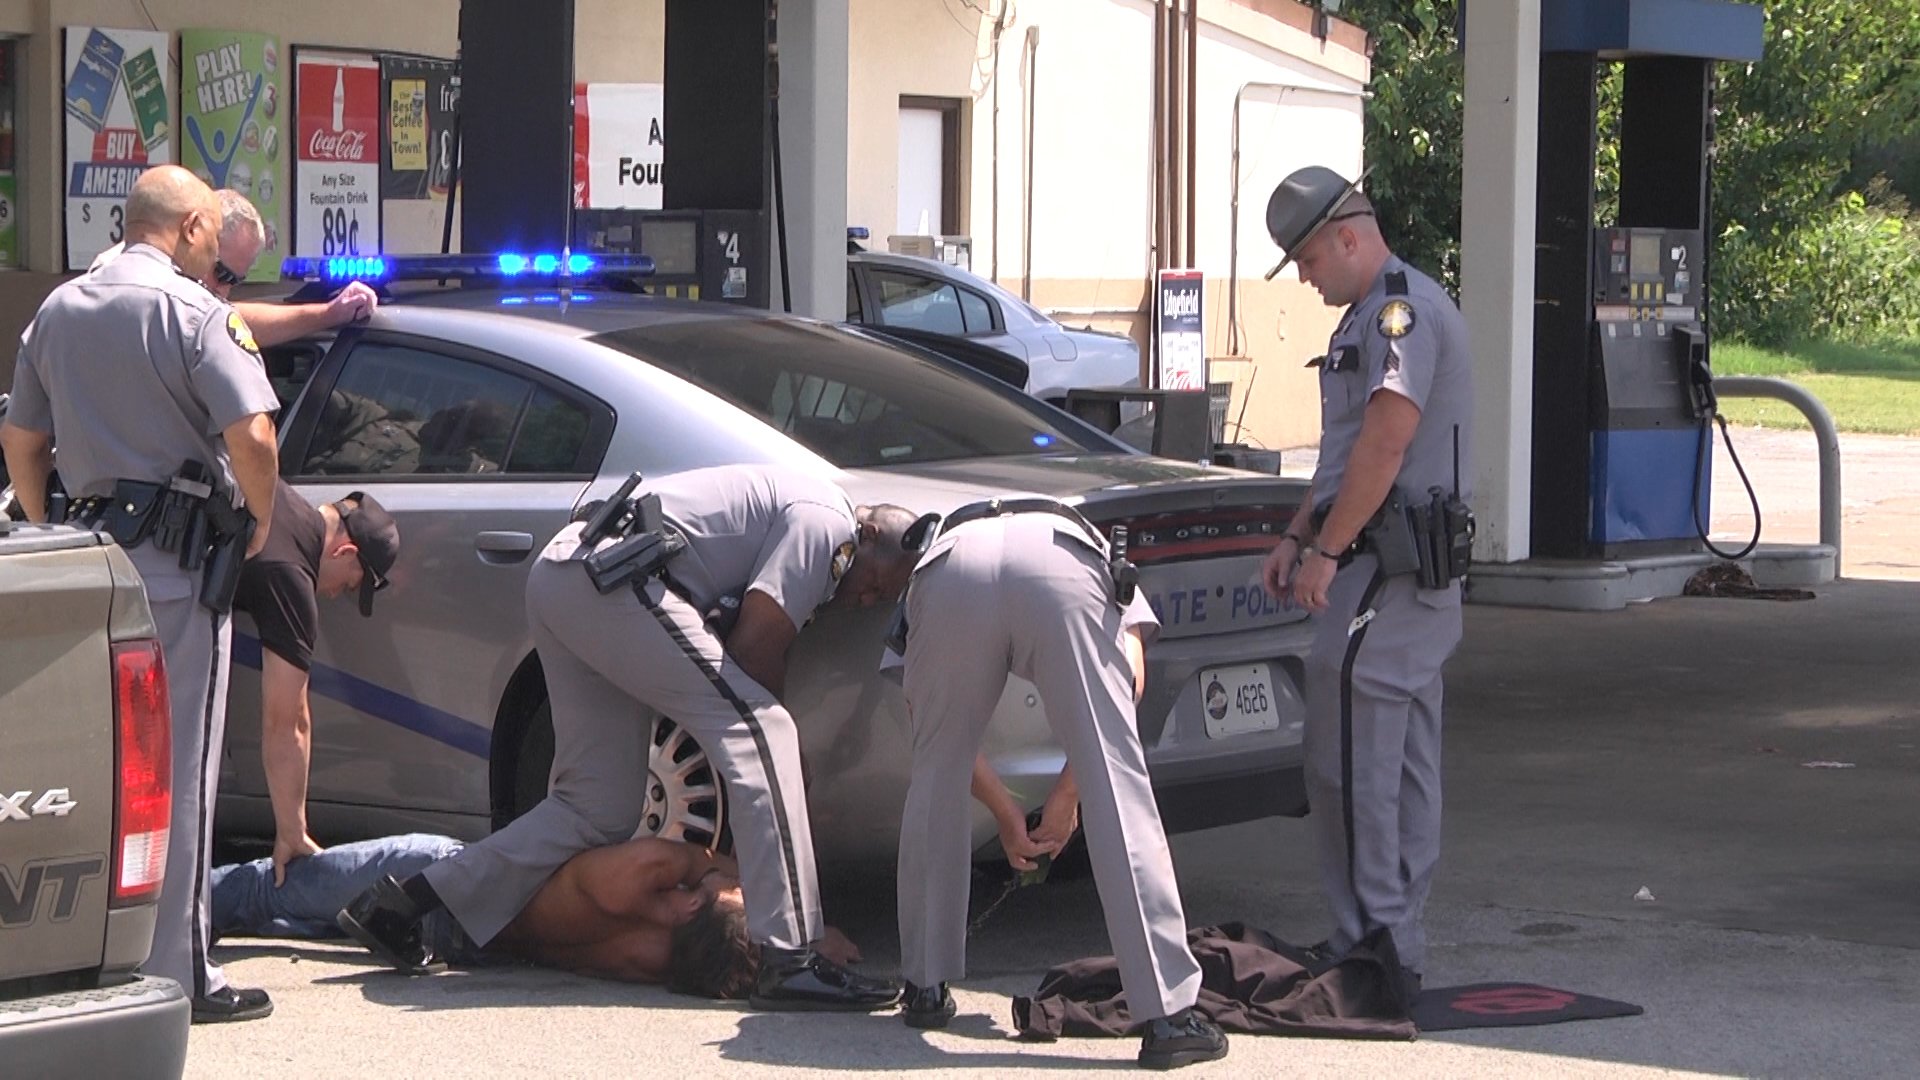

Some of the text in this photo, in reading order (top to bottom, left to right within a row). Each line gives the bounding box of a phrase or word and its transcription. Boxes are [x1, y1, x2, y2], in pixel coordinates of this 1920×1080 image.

[195, 43, 241, 83] PLAY
[196, 71, 254, 114] HERE!
[392, 115, 423, 128] Coffee
[106, 131, 136, 161] BUY
[392, 141, 423, 154] Town!
[81, 166, 143, 195] AMERIC
[322, 173, 355, 189] Any Size
[310, 190, 368, 205] Fountain Drink
[725, 232, 740, 264] 4
[1677, 244, 1687, 269] 2
[1163, 288, 1199, 320] Edgefield
[1236, 683, 1268, 715] 4626
